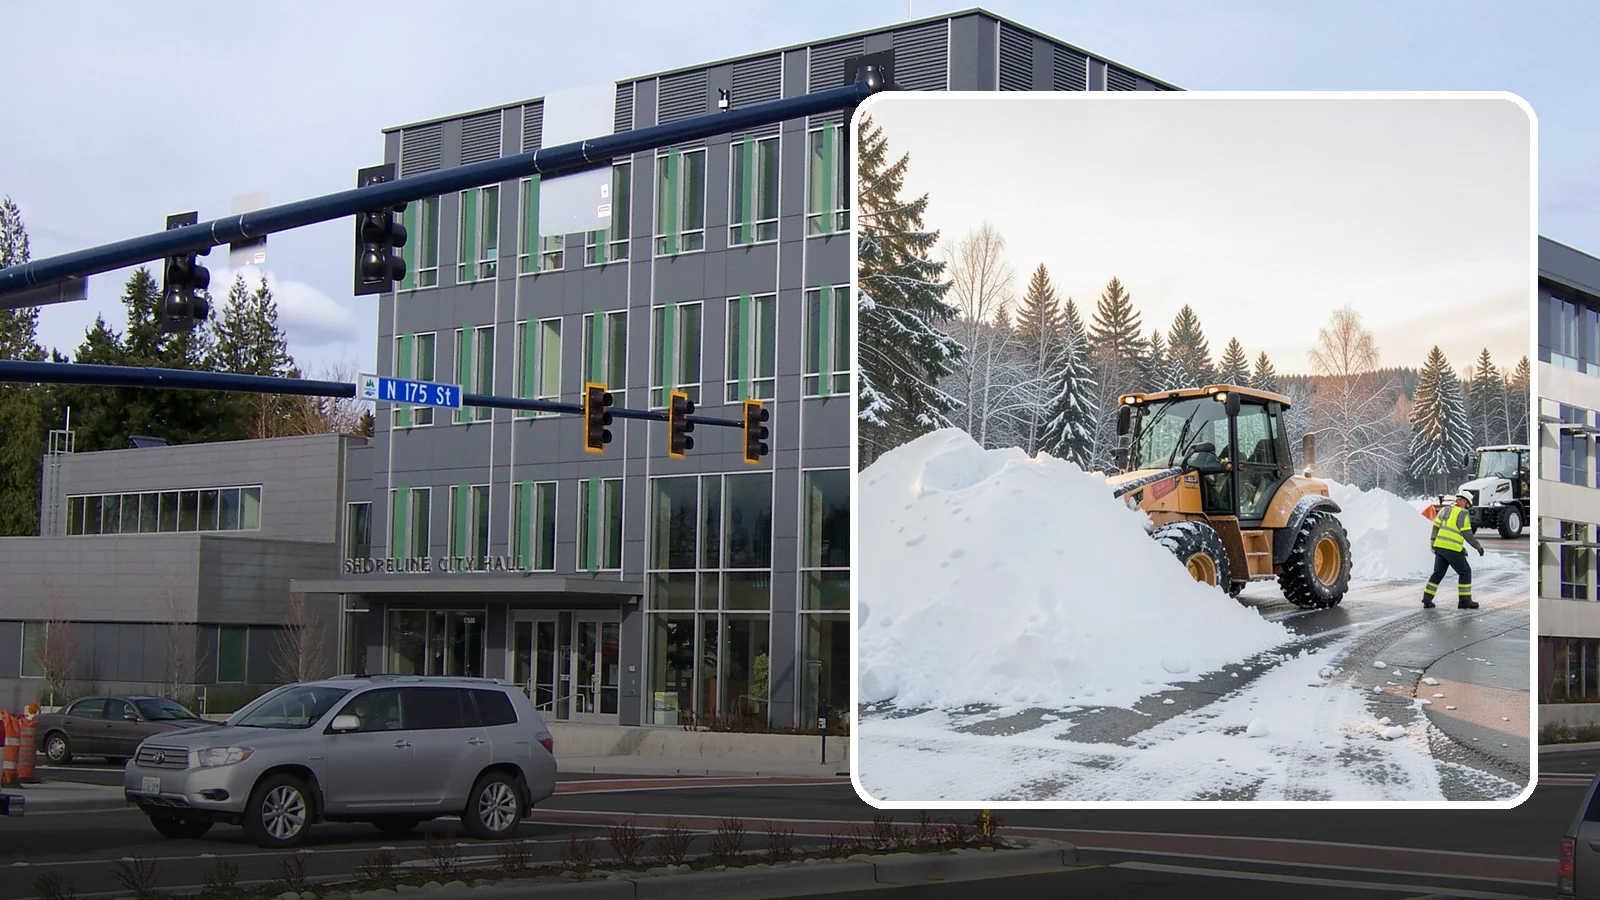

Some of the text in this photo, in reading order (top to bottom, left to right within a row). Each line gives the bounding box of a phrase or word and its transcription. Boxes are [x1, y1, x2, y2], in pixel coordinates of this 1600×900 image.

[387, 380, 451, 406] N 175 St
[343, 555, 526, 574] SHORELINE CITY HALL
